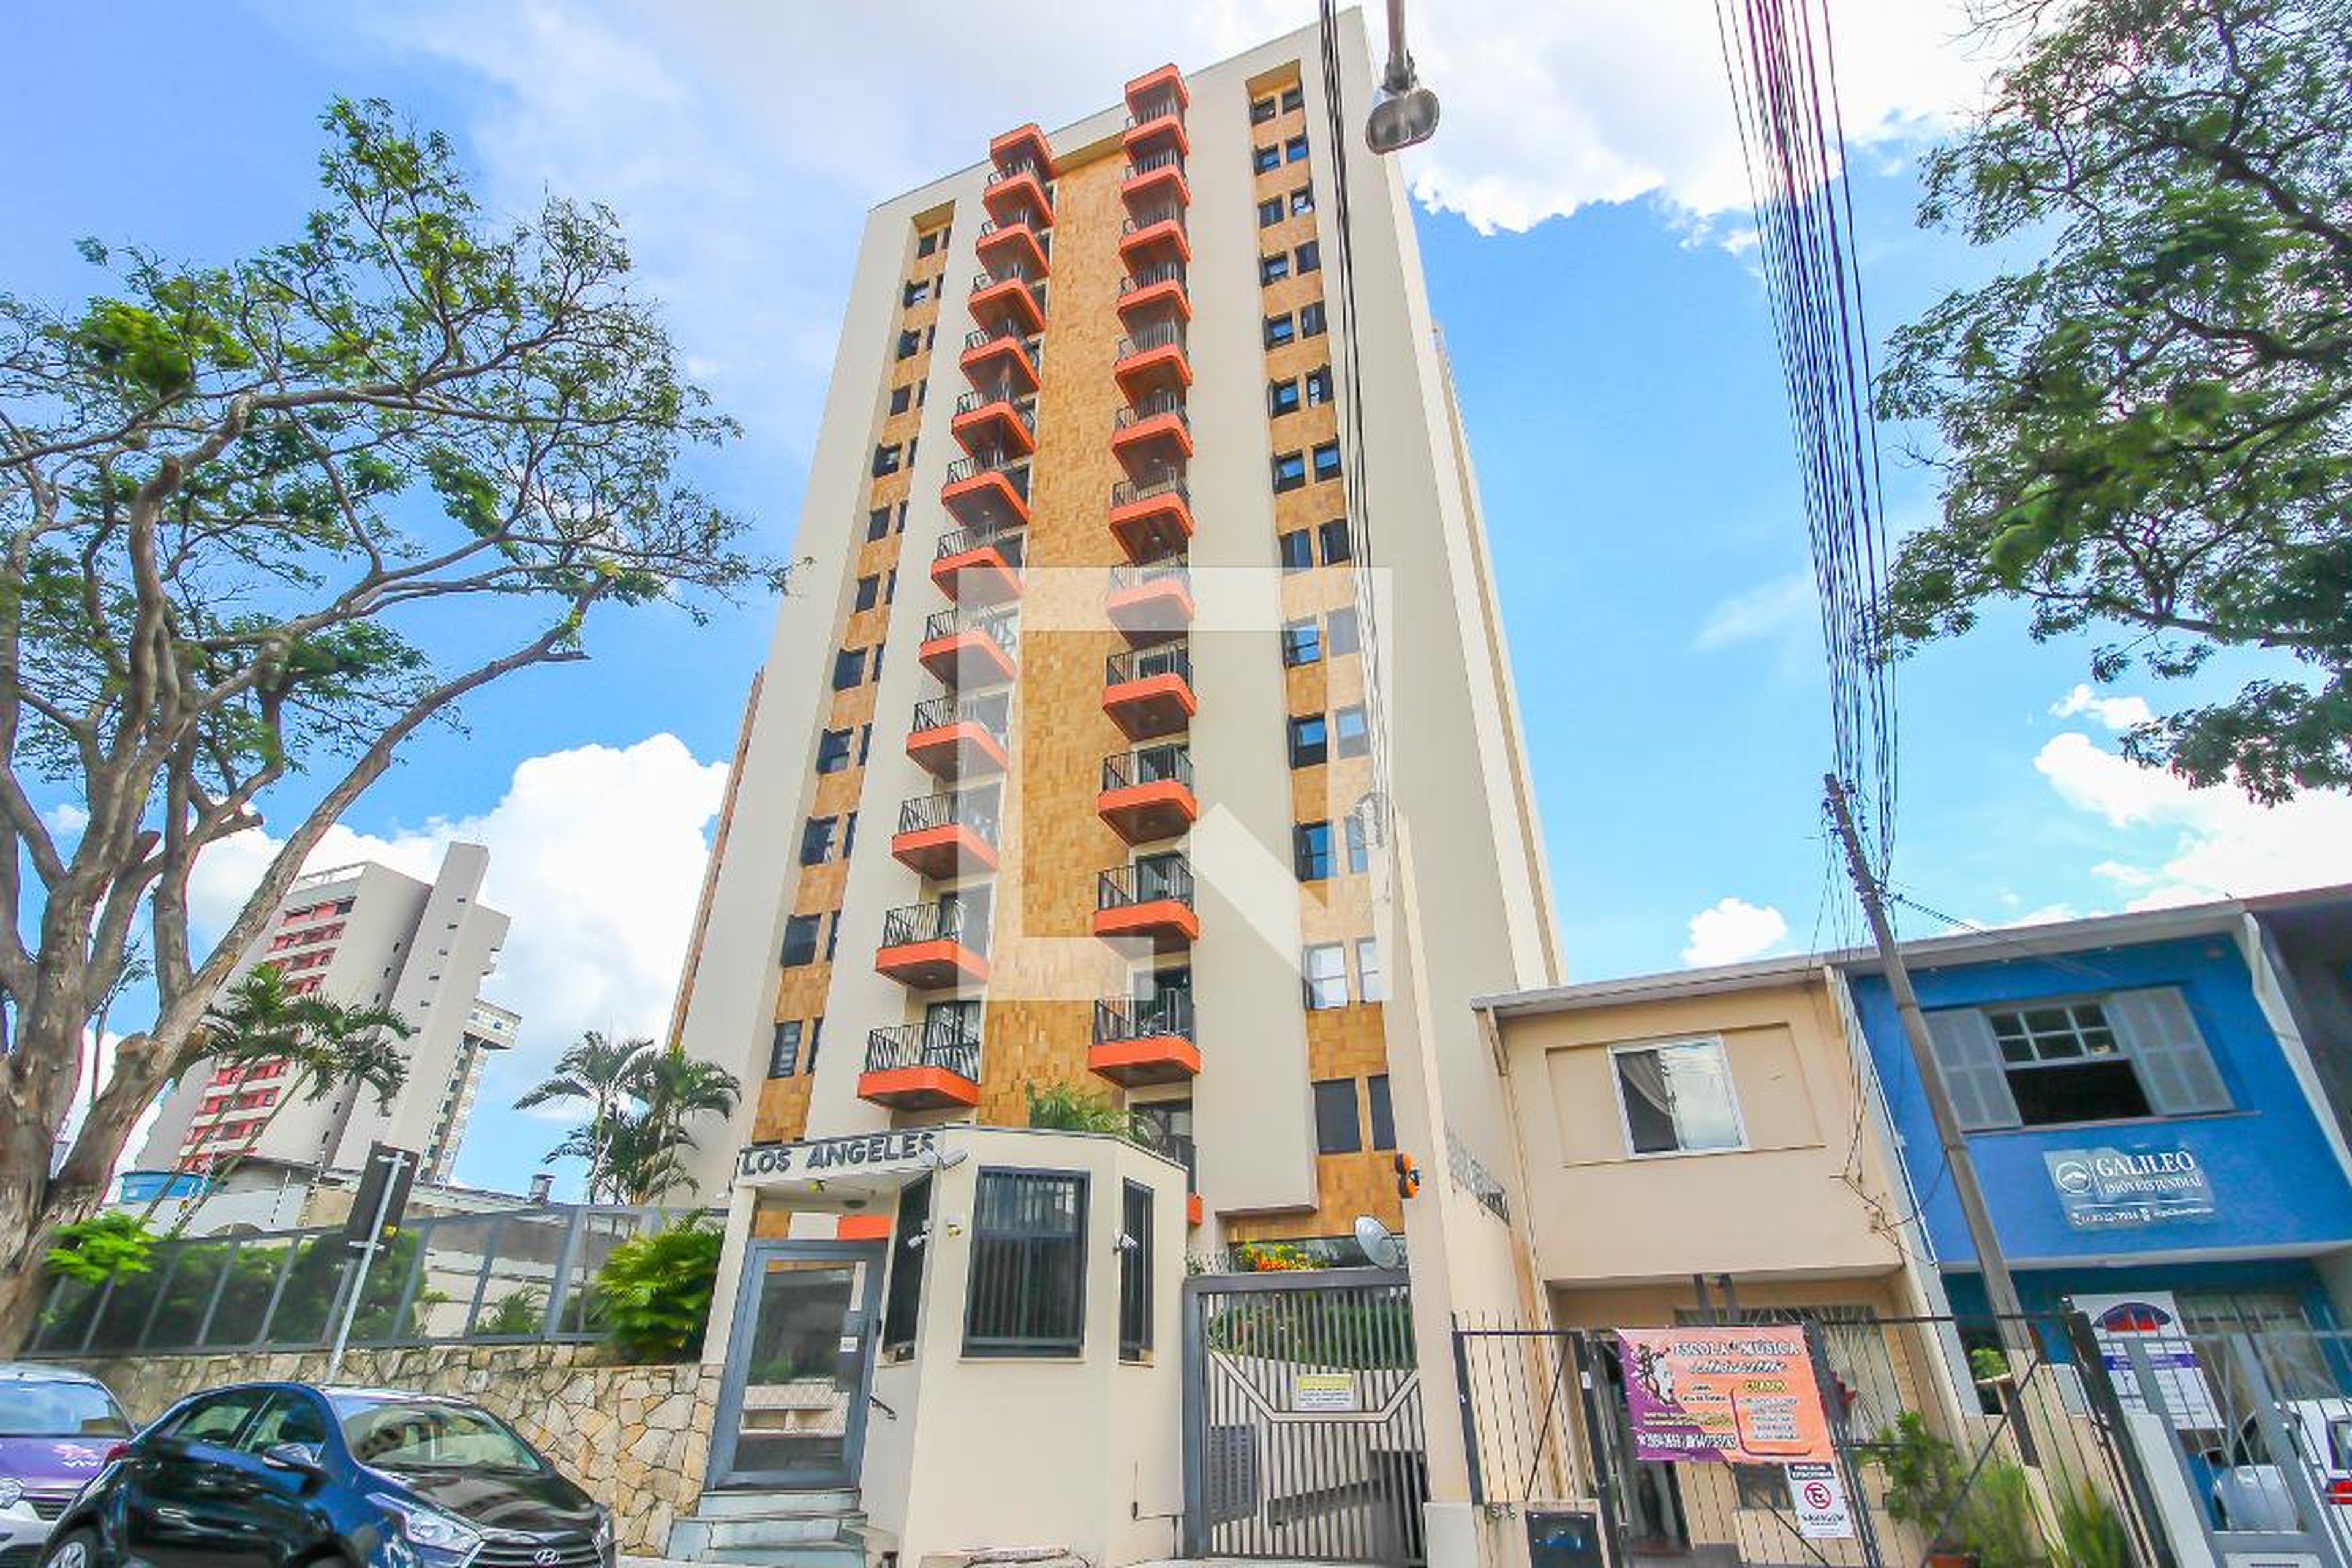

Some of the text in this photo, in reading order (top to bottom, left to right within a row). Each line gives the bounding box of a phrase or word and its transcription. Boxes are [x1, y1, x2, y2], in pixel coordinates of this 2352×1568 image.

[741, 1133, 935, 1176] LOS ANGELES
[2096, 1151, 2196, 1177] GALILEO
[1673, 1341, 1730, 1355] ESCOLA
